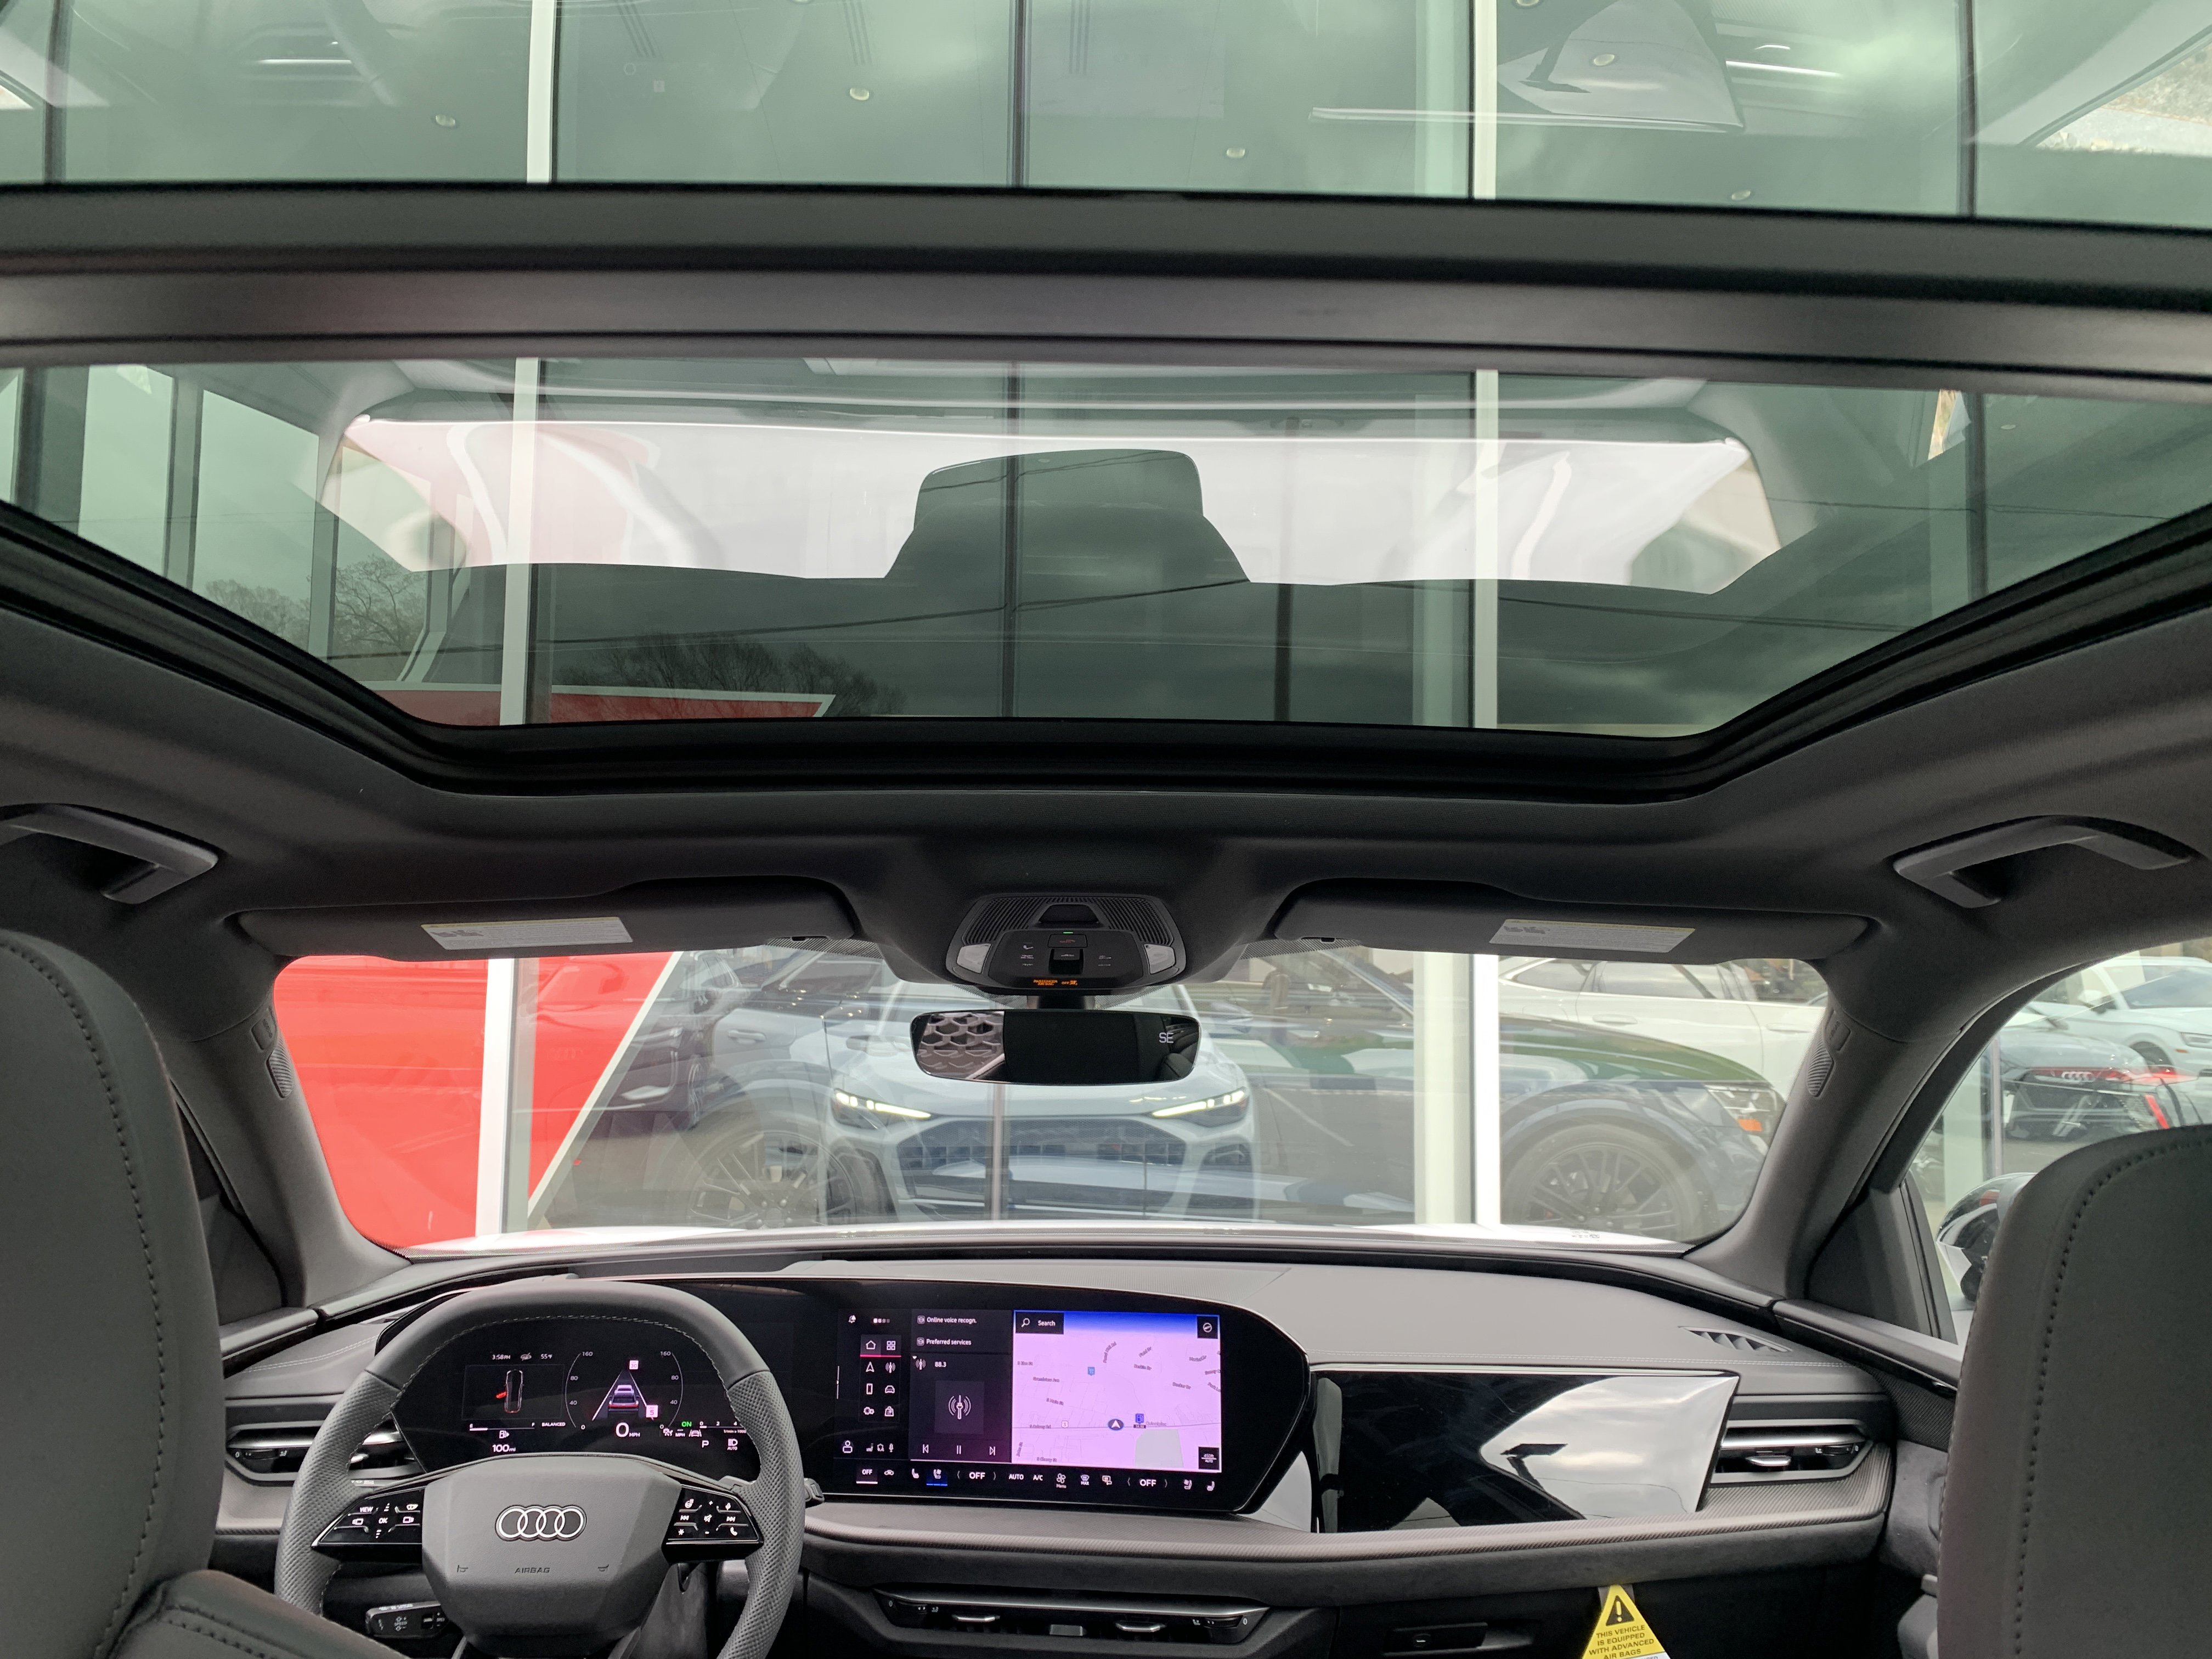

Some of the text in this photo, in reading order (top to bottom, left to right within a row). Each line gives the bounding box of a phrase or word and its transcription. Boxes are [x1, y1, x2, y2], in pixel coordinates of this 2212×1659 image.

[1159, 1032, 1174, 1043] SE
[616, 1422, 629, 1437] 0
[702, 1440, 709, 1448] P
[969, 1471, 986, 1480] OFF
[1139, 1479, 1156, 1487] OFF
[1596, 1624, 1645, 1639] THIS VEHICLE
[1607, 1633, 1645, 1644] EQUIPPED
[1589, 1638, 1655, 1655] WITH ADVANCED
[1620, 1649, 1641, 1657] BAGS
